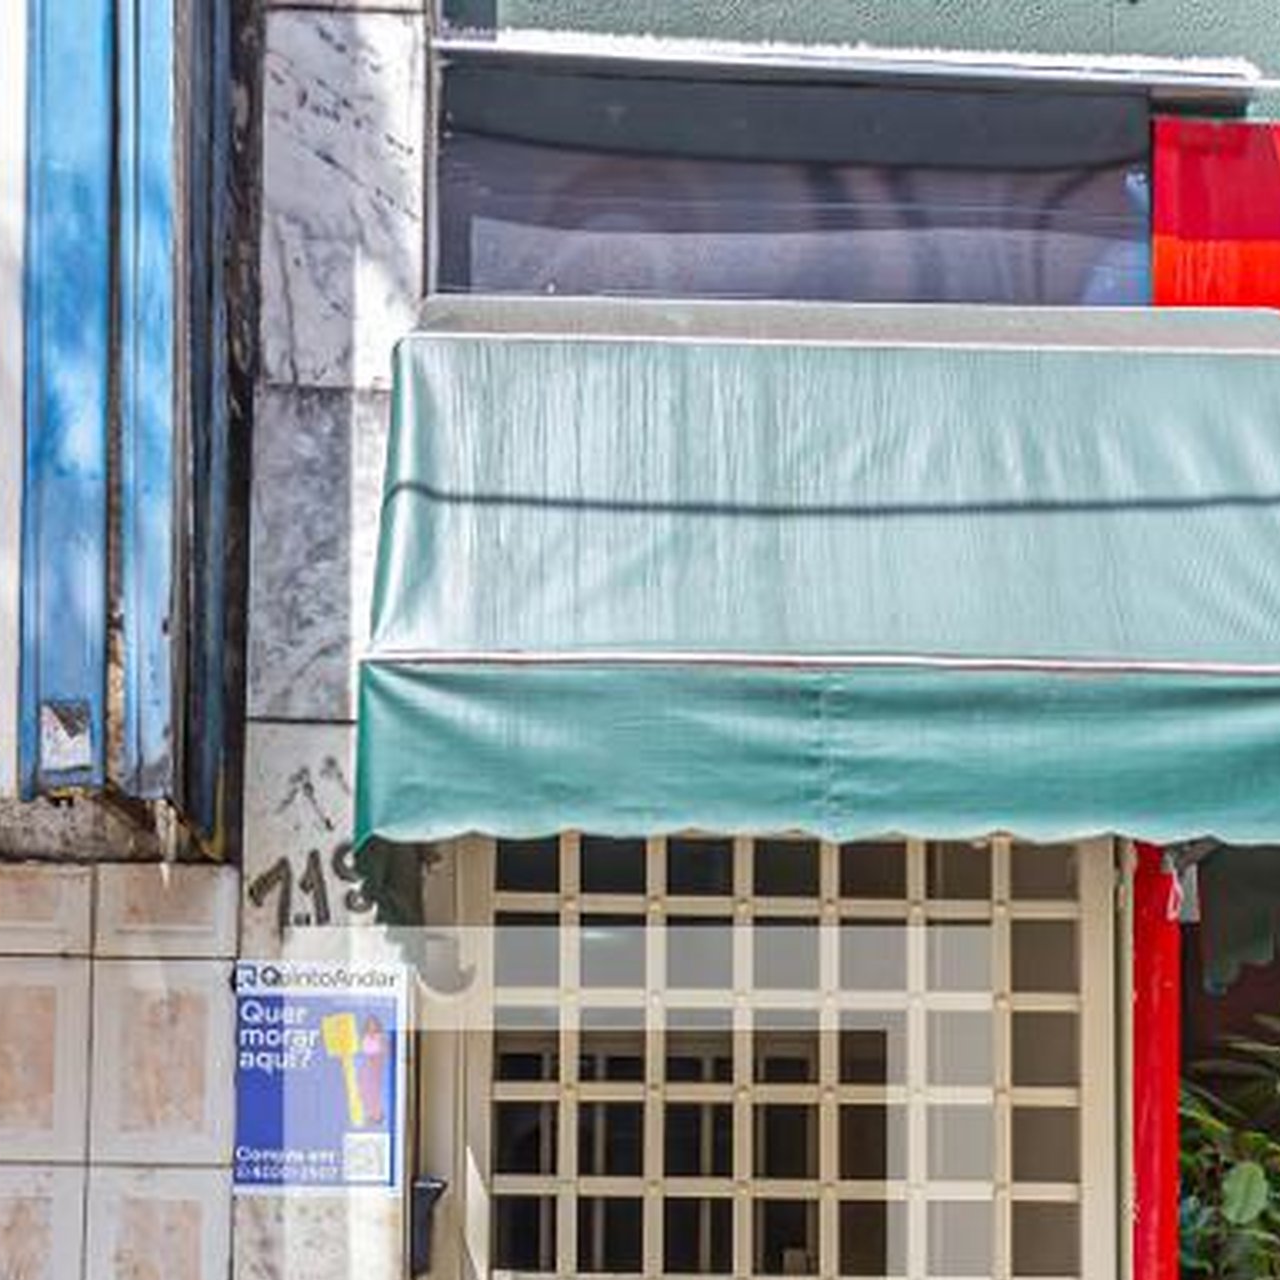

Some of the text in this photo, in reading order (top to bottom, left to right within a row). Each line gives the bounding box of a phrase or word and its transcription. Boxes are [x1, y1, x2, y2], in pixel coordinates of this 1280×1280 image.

[260, 965, 396, 988] QuintoAndar
[239, 1000, 308, 1024] Quer
[239, 1027, 321, 1047] morar
[239, 1047, 314, 1074] aqui?
